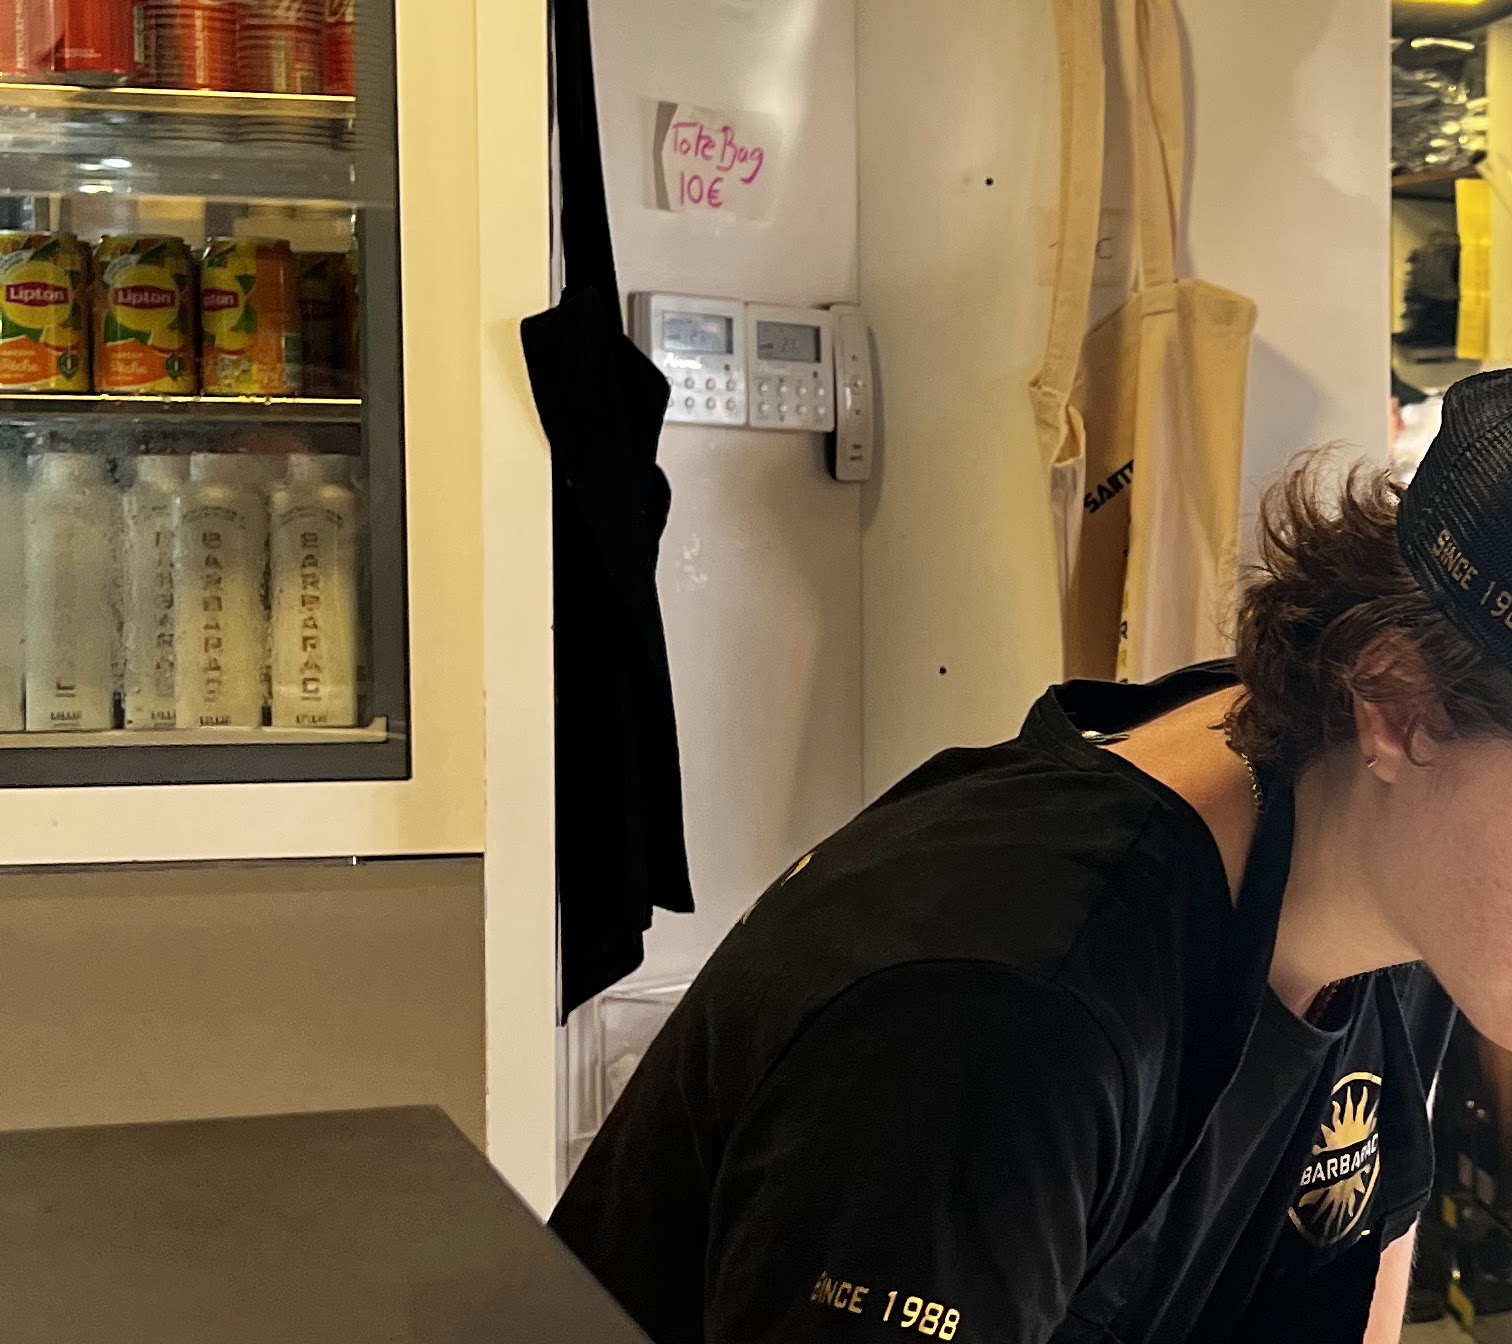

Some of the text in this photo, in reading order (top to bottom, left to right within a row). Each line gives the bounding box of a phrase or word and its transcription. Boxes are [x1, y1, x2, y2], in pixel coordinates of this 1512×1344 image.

[673, 122, 764, 185] Tote Bag
[680, 171, 724, 208] 10€
[10, 286, 65, 304] Lipton
[117, 289, 172, 307] Lipton
[1431, 527, 1480, 591] SINCE
[882, 1290, 961, 1341] 1988
